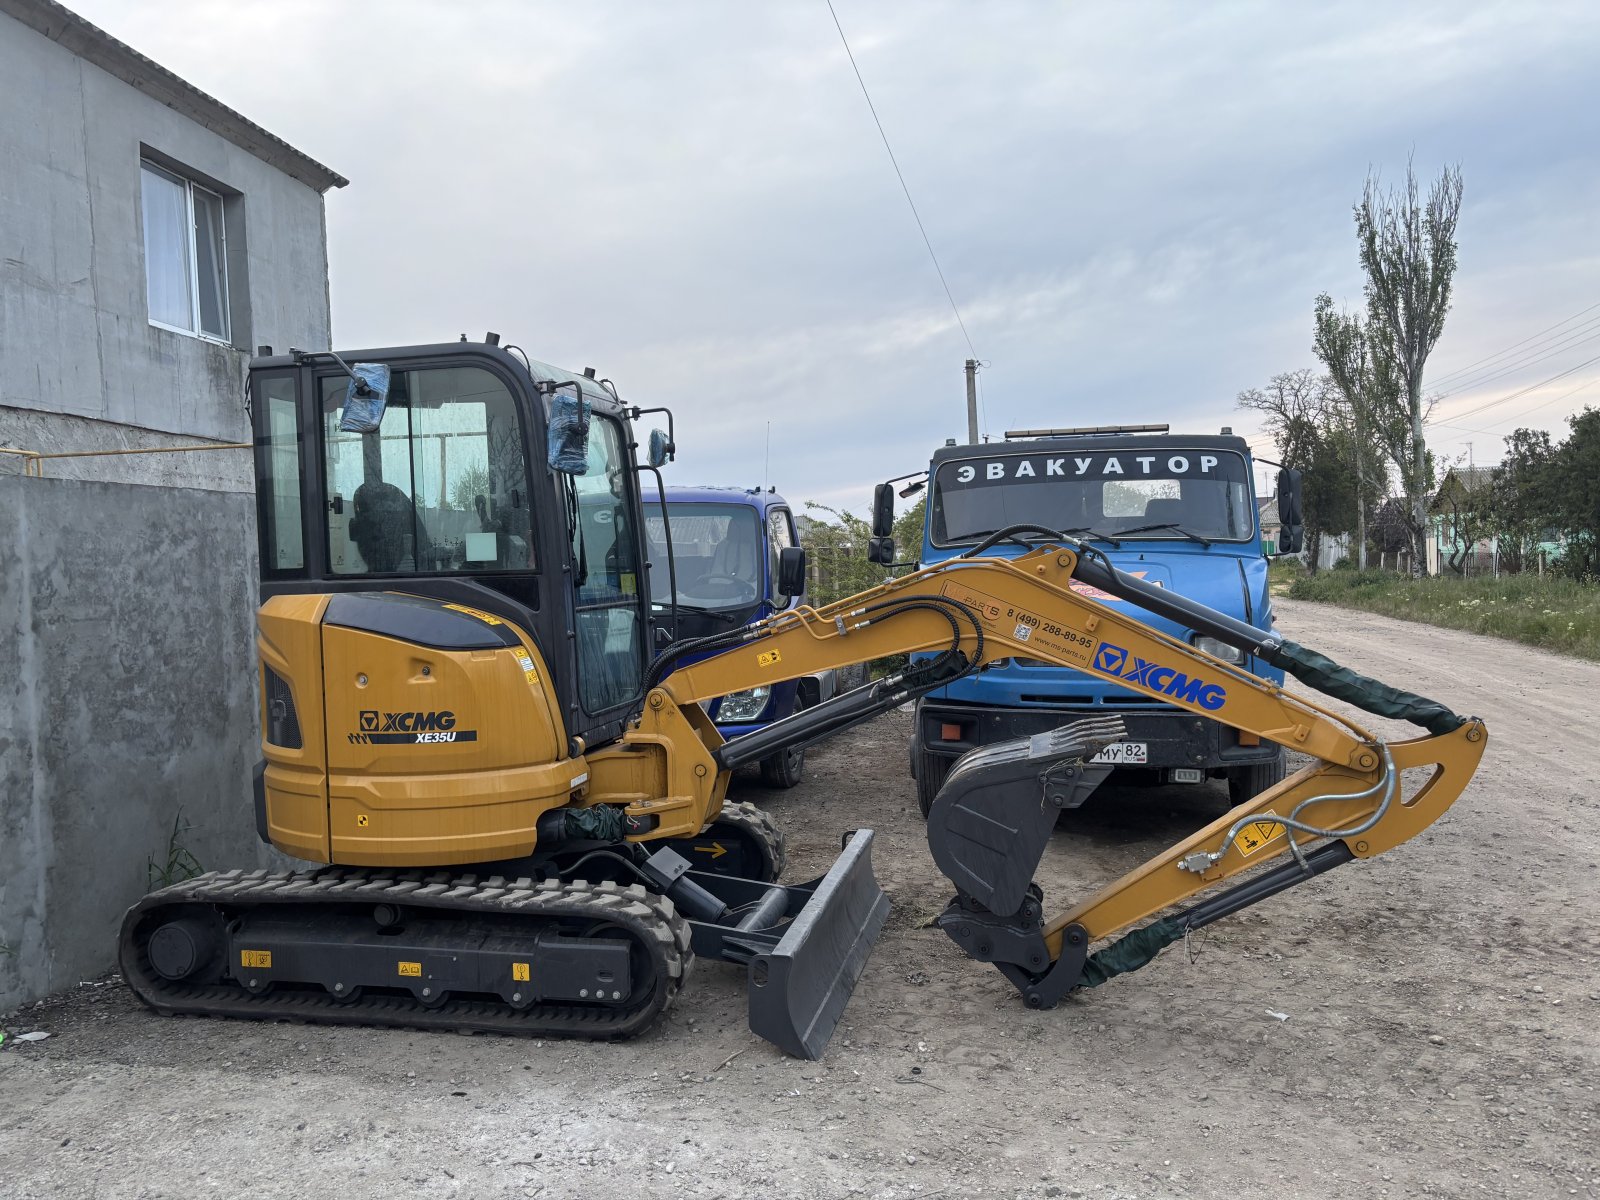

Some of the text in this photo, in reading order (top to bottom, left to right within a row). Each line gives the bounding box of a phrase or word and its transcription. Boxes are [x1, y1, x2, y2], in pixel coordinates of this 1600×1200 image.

[957, 455, 1218, 483] ЭВАКУАТОР
[1006, 608, 1014, 618] 8
[1015, 611, 1041, 630] (499)
[1042, 622, 1093, 649] 288-89-95
[1034, 635, 1087, 662] www.ms-parts.ru
[1120, 656, 1227, 711] XCMG
[380, 710, 456, 732] XCMG
[415, 732, 457, 744] XE35U
[1125, 744, 1142, 757] 82
